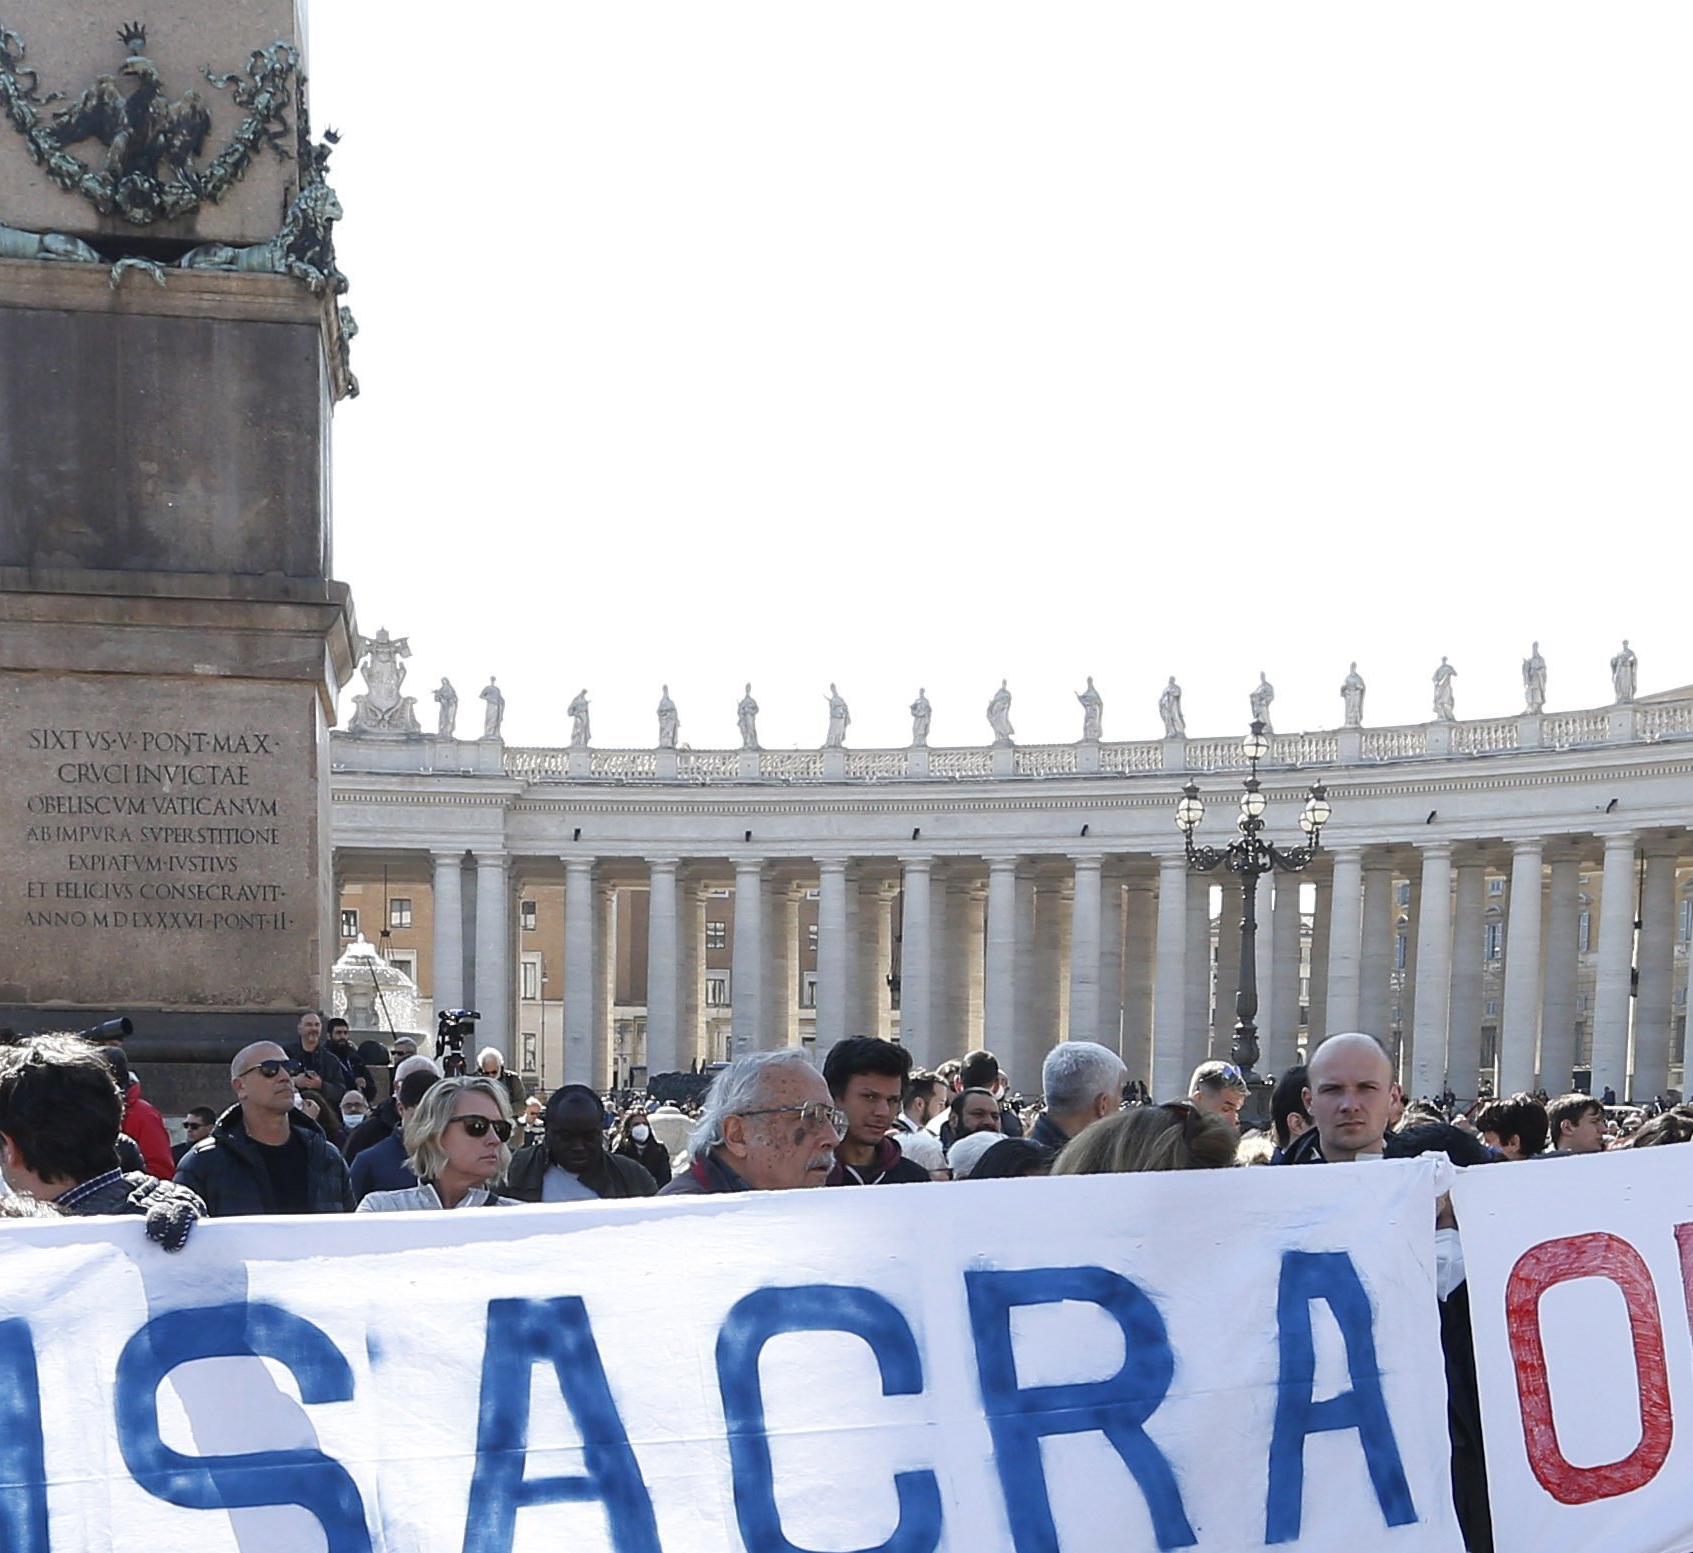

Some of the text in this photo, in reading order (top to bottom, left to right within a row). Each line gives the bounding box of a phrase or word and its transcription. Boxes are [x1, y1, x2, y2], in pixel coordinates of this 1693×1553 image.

[58, 763, 250, 786] CRVCI INVICTAE
[27, 795, 278, 817] OBELISCVM VATICANVM
[26, 825, 280, 845] AB IMPVRA SVPERSTITIONE
[169, 855, 238, 873] IVSTIVS
[27, 881, 47, 899] ET
[55, 882, 134, 900] FELICIVS
[25, 910, 86, 928] ANNO
